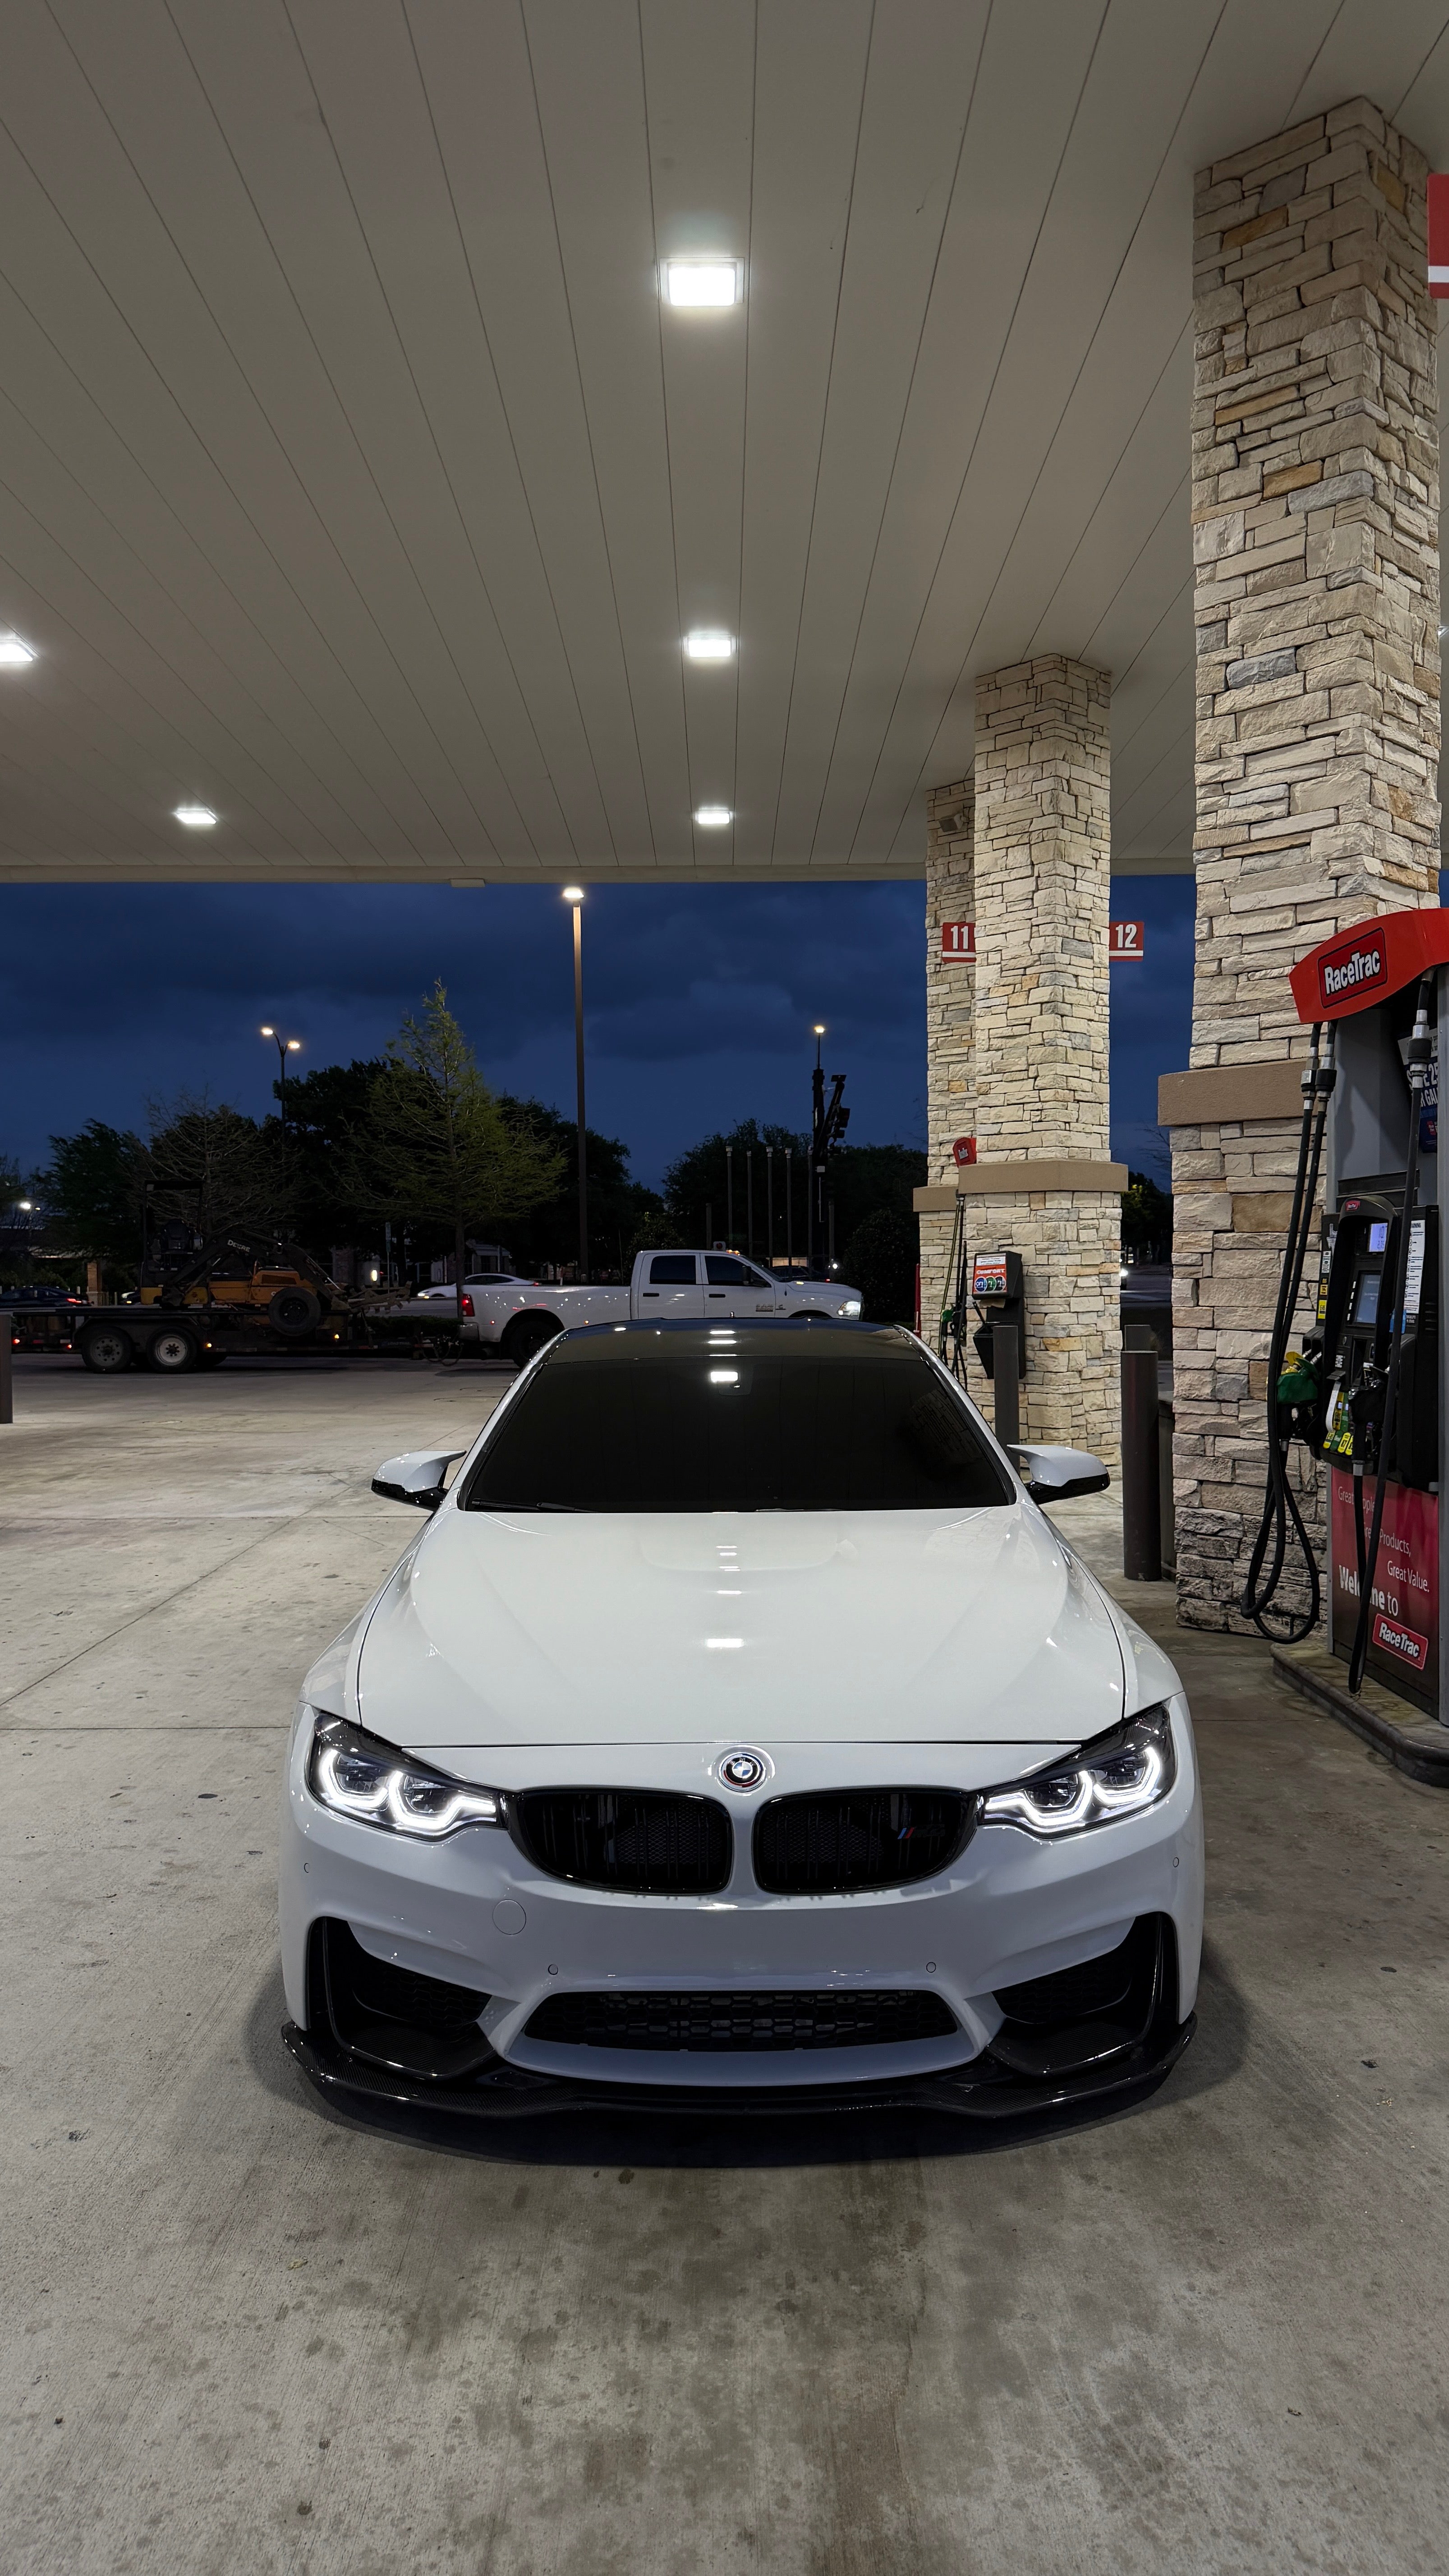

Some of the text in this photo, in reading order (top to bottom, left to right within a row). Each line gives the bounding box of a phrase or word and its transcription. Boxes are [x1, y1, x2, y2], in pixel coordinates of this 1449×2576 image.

[951, 925, 968, 949] 11
[1115, 924, 1137, 948] 12
[1325, 951, 1380, 994] RaceTrac
[227, 1239, 250, 1252] DEERE
[1338, 1486, 1354, 1504] Great
[1380, 1528, 1411, 1557] Products,
[1339, 1565, 1398, 1616] Welme to
[1387, 1560, 1430, 1593] Great Value.
[1379, 1622, 1420, 1657] RaceTrac
